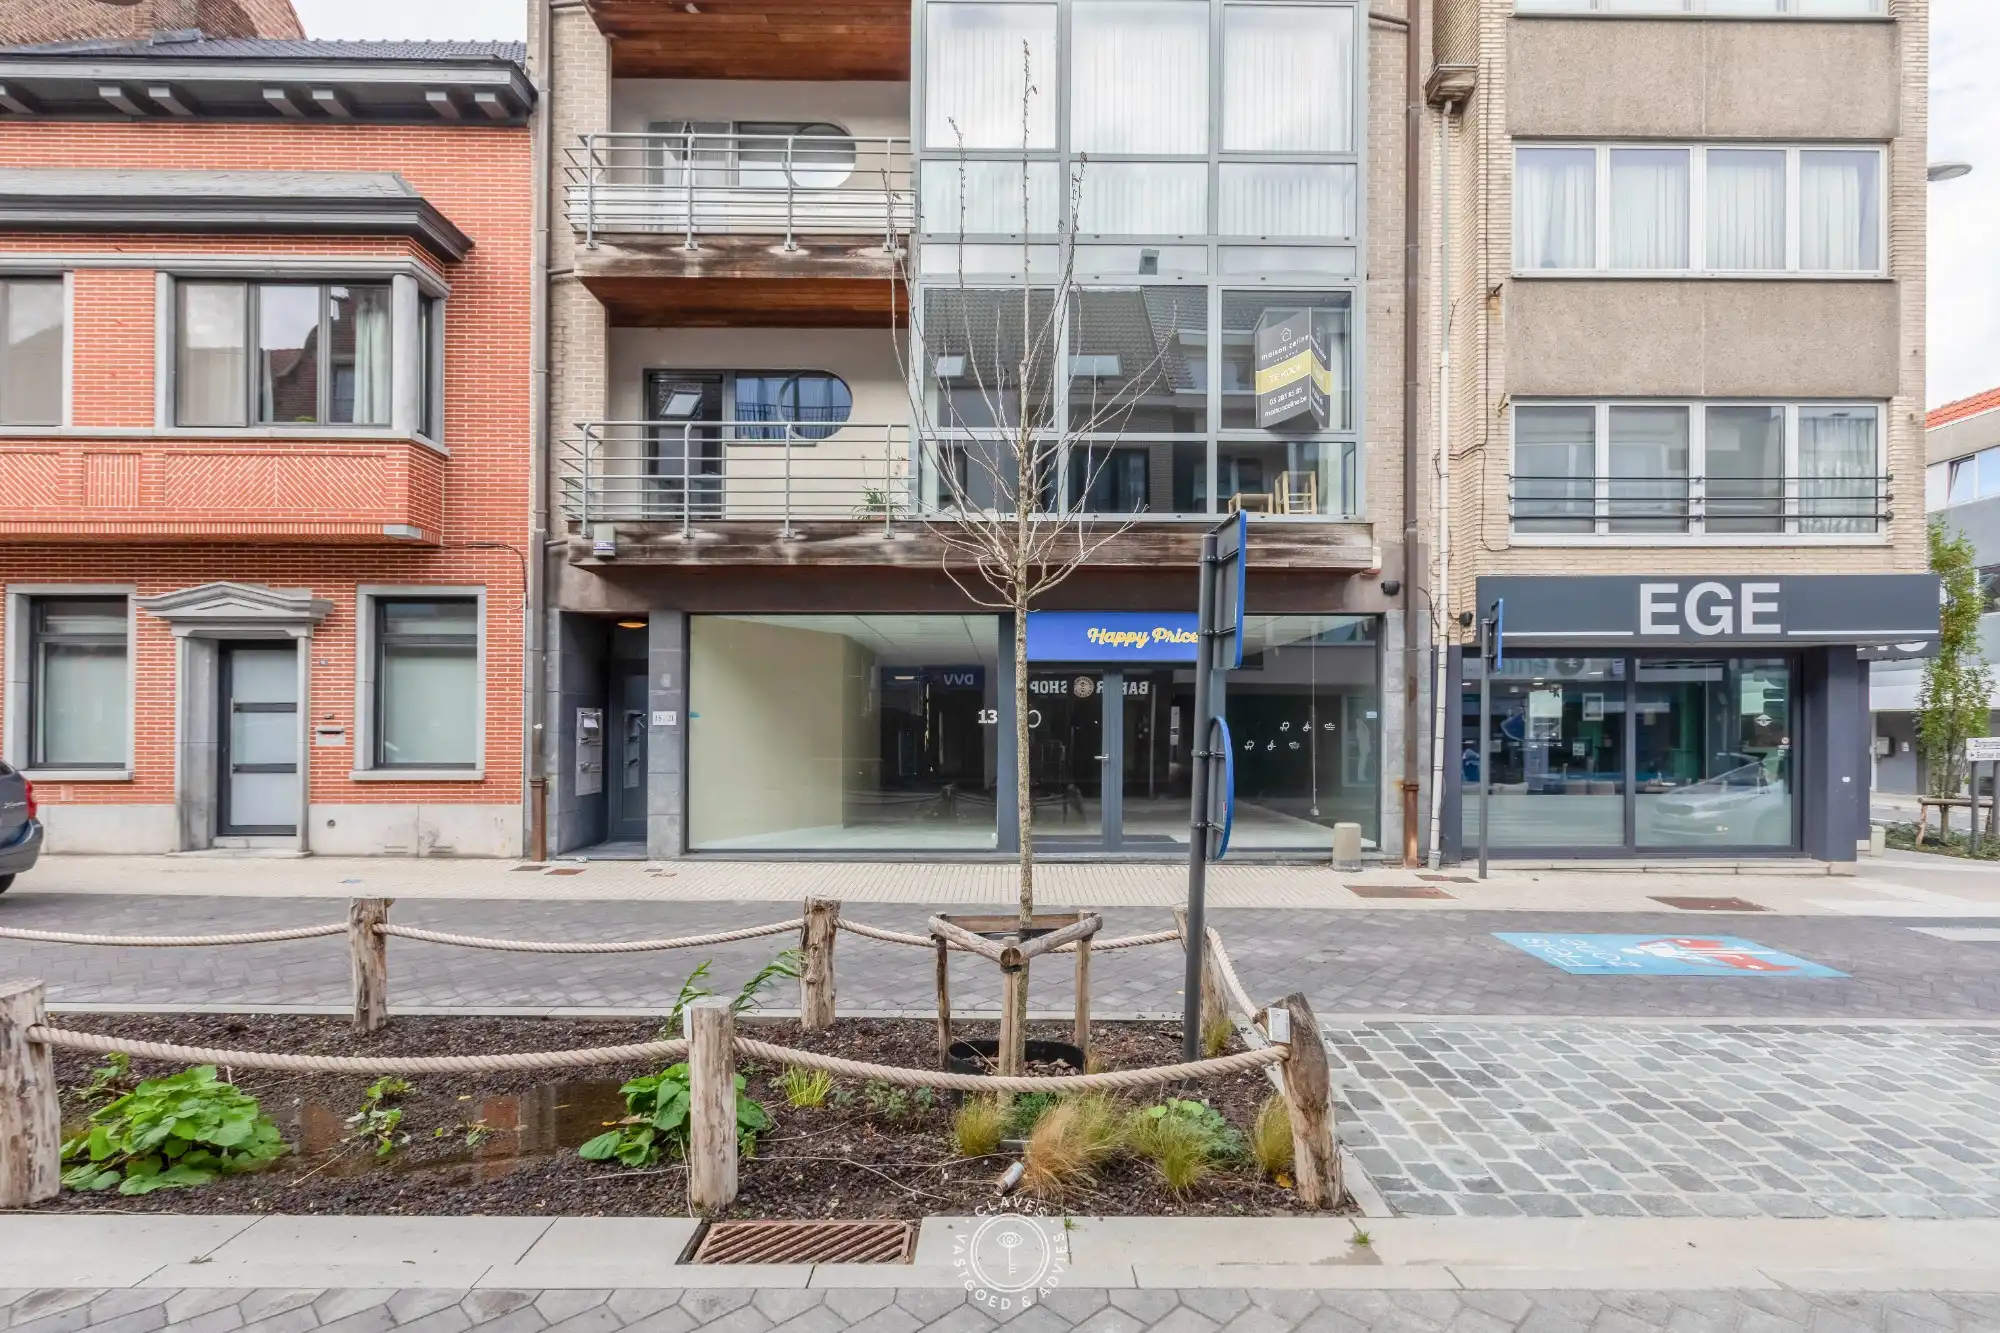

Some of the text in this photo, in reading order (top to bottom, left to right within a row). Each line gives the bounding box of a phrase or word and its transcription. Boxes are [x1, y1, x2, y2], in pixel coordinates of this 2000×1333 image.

[1261, 345, 1287, 360] maison
[1640, 582, 1781, 636] EGE
[1087, 627, 1150, 649] Happy
[977, 708, 998, 724] 13
